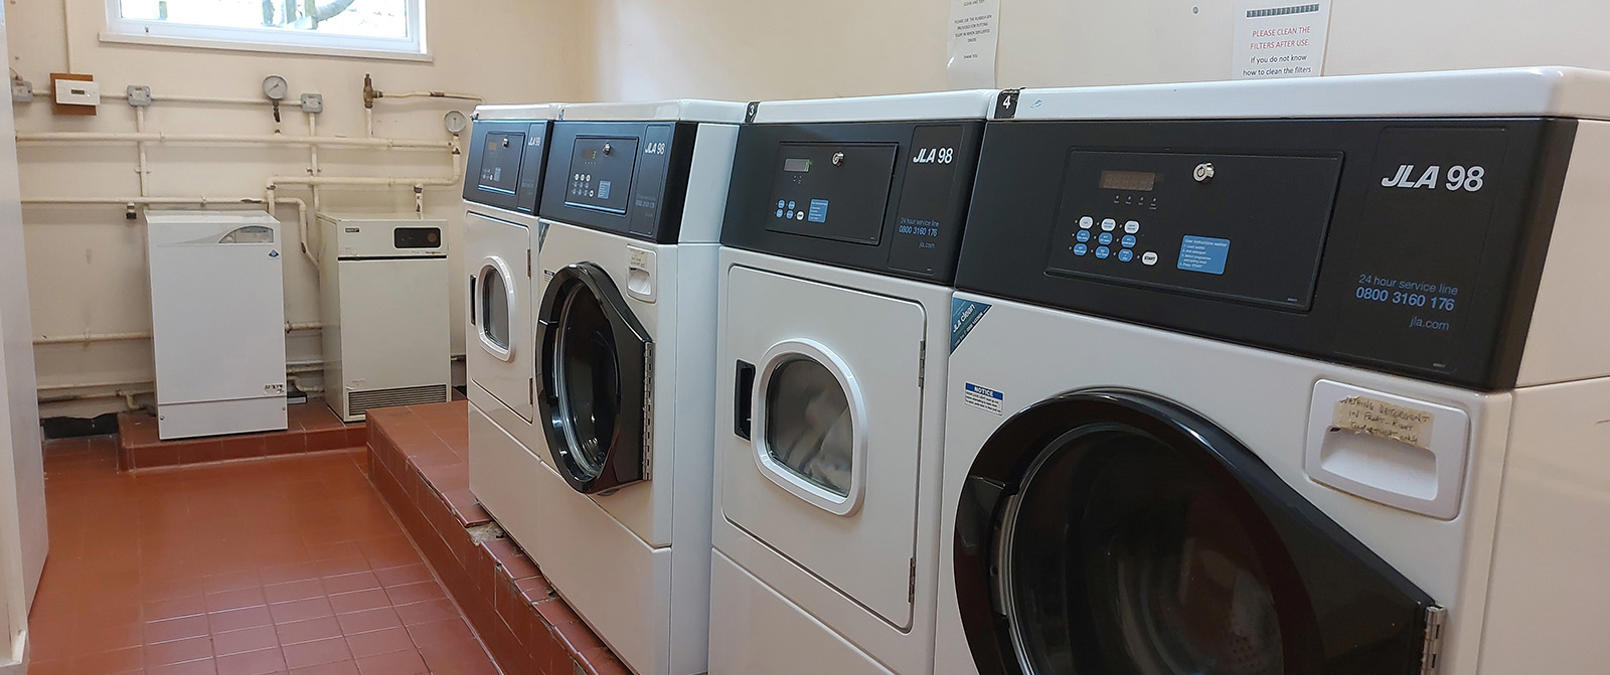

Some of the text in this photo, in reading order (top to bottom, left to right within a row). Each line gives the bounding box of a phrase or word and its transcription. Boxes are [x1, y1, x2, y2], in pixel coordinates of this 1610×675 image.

[1252, 26, 1311, 38] PLEASE CLEAN THE
[1250, 42, 1275, 50] FILTERS
[1275, 40, 1296, 48] AFTER
[1256, 57, 1269, 66] you
[1269, 55, 1278, 63] do
[1242, 69, 1257, 77] how
[1266, 68, 1283, 76] clean
[1284, 66, 1294, 74] the
[1295, 66, 1312, 74] filters
[1002, 95, 1011, 109] 4
[748, 104, 755, 116] 3
[912, 147, 954, 164] JLA 98
[1381, 165, 1485, 192] JLA 98
[1359, 274, 1459, 296] 24 hour service line
[1355, 287, 1456, 312] 0800 3160 176
[960, 304, 976, 321] clean
[1409, 316, 1450, 331] jla.com
[974, 386, 994, 397] NOTICE
